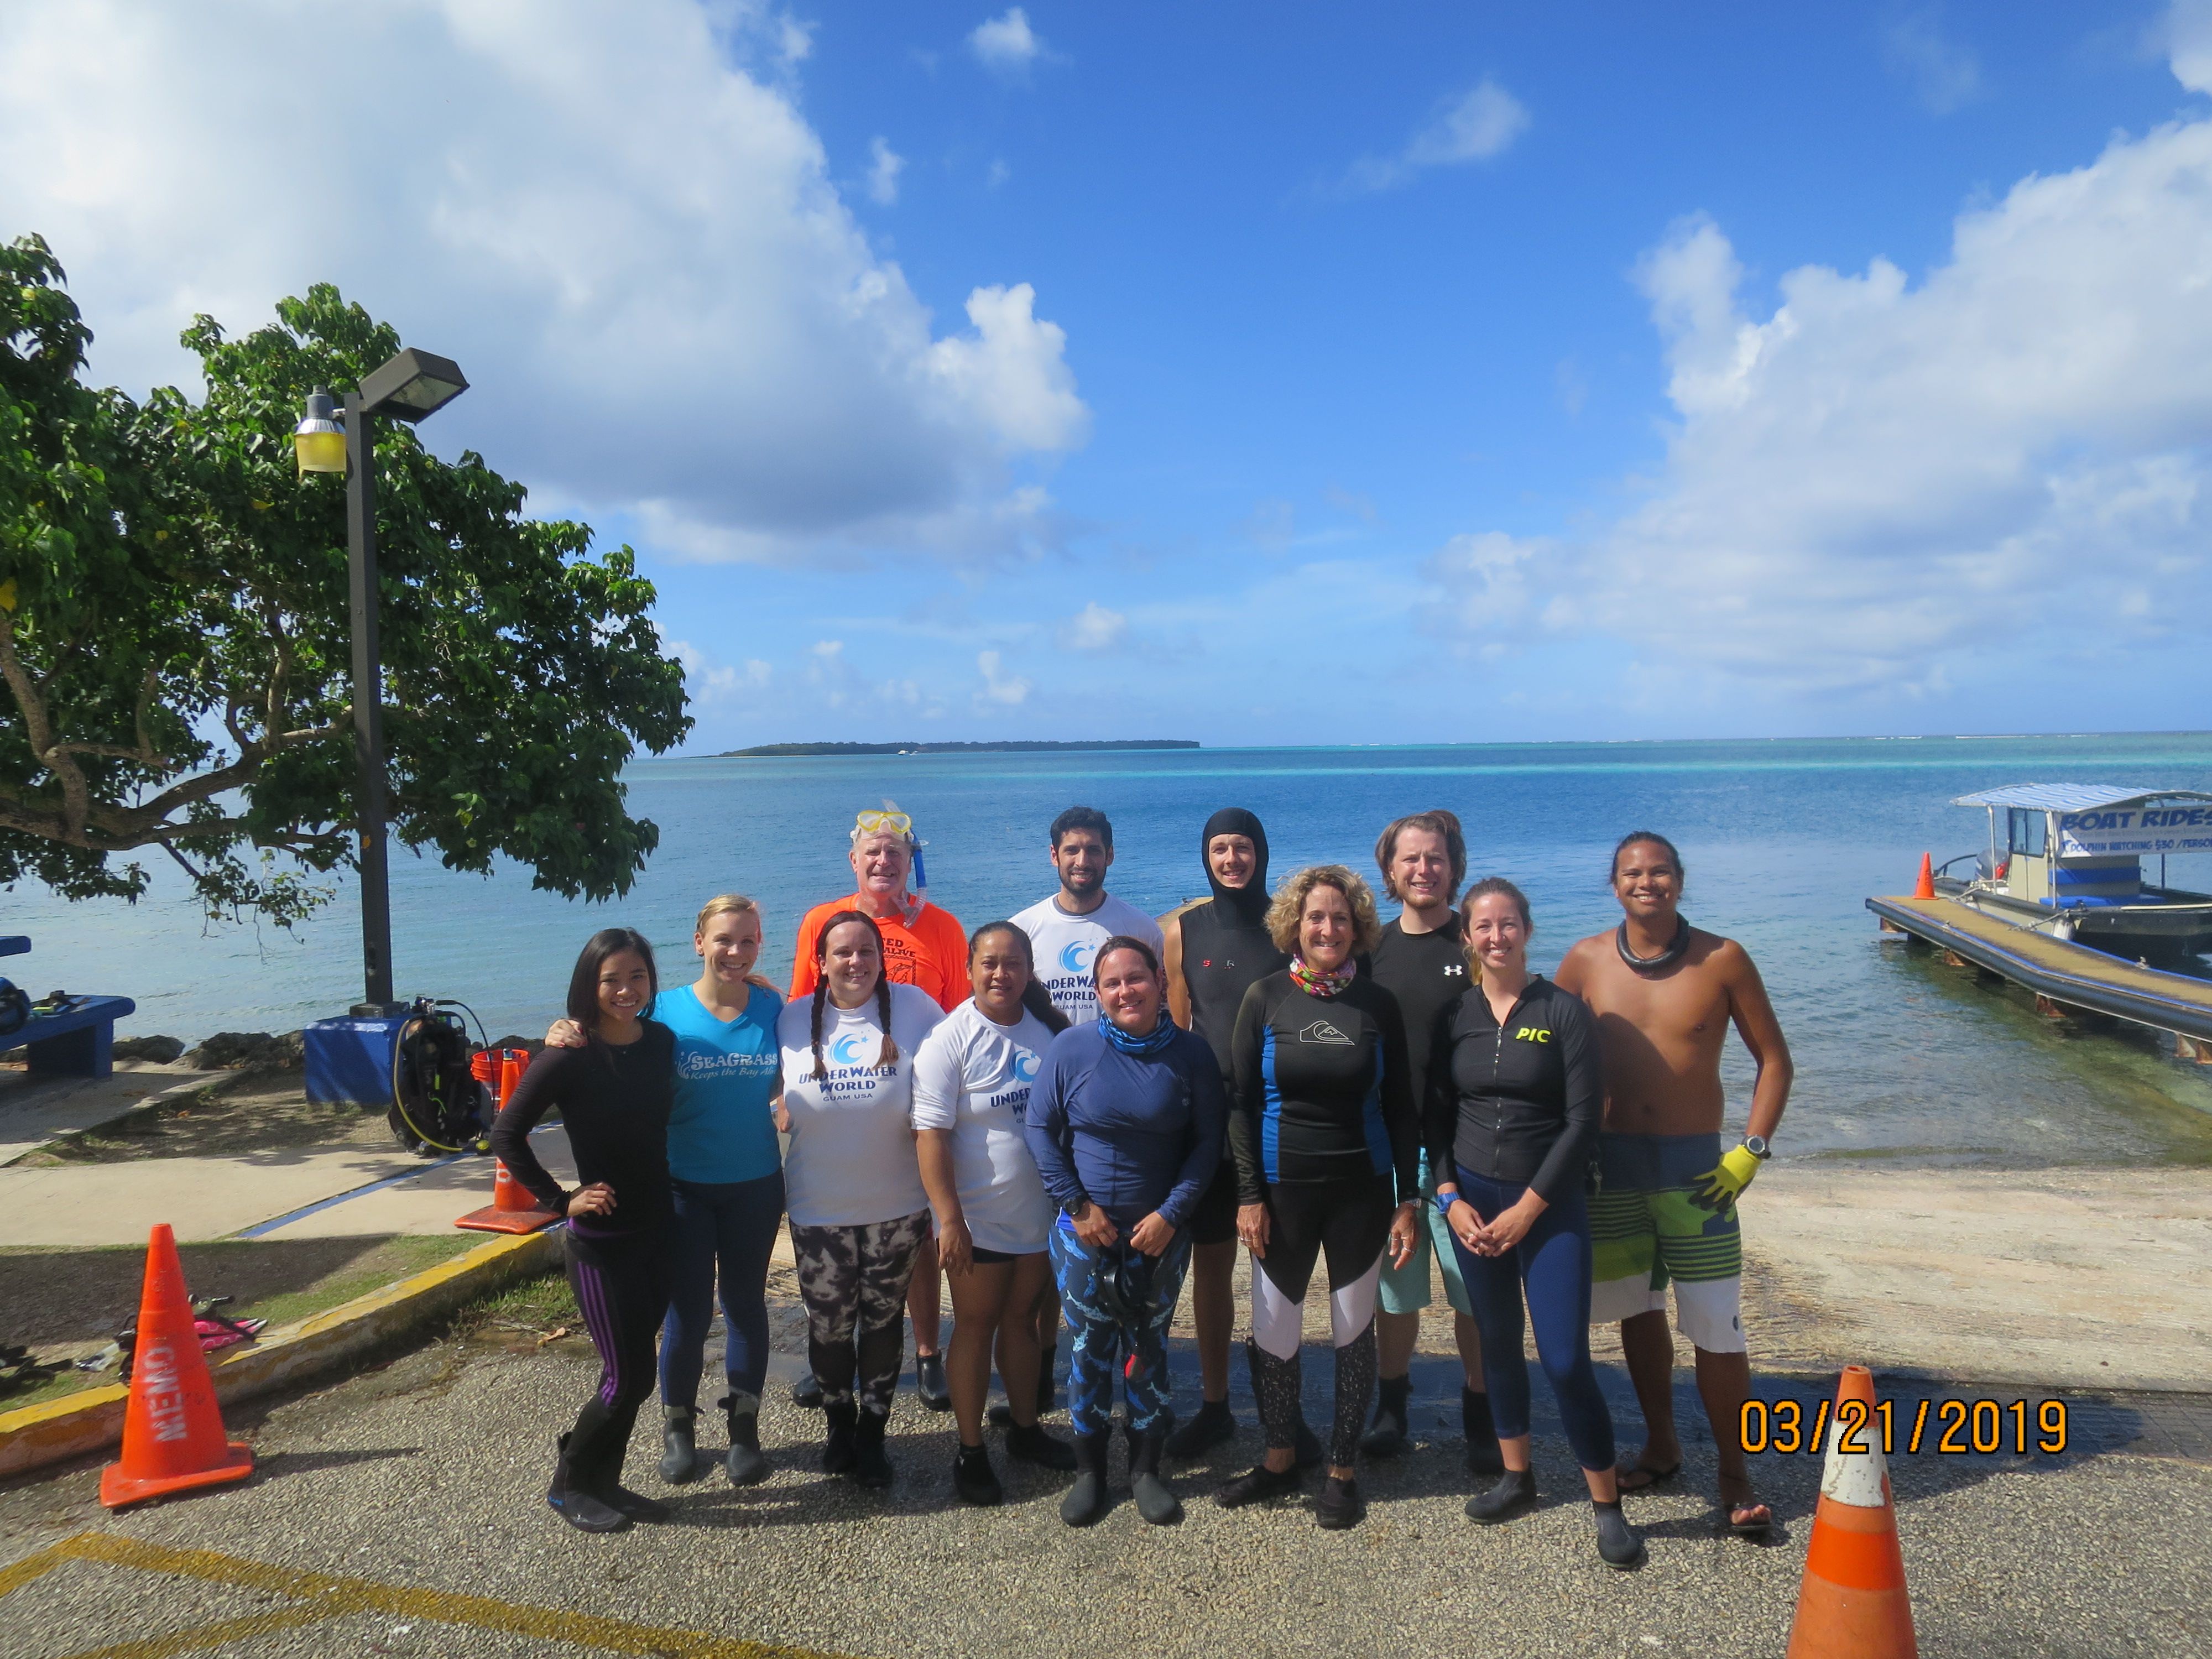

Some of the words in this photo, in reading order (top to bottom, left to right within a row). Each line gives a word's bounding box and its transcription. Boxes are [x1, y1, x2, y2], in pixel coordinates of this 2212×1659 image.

[2060, 812, 2136, 830] BOAT
[2071, 842, 2107, 852] DOLPHIN
[2110, 841, 2152, 851] WATCHING
[882, 938, 904, 948] ED
[1052, 991, 1097, 1002] WORLD
[1516, 1027, 1551, 1043] PIC
[691, 1052, 778, 1071] SEAGRASS
[692, 1071, 719, 1082] Keeps
[721, 1067, 736, 1076] the
[739, 1067, 759, 1078] Bay
[819, 1080, 876, 1093] WORLD
